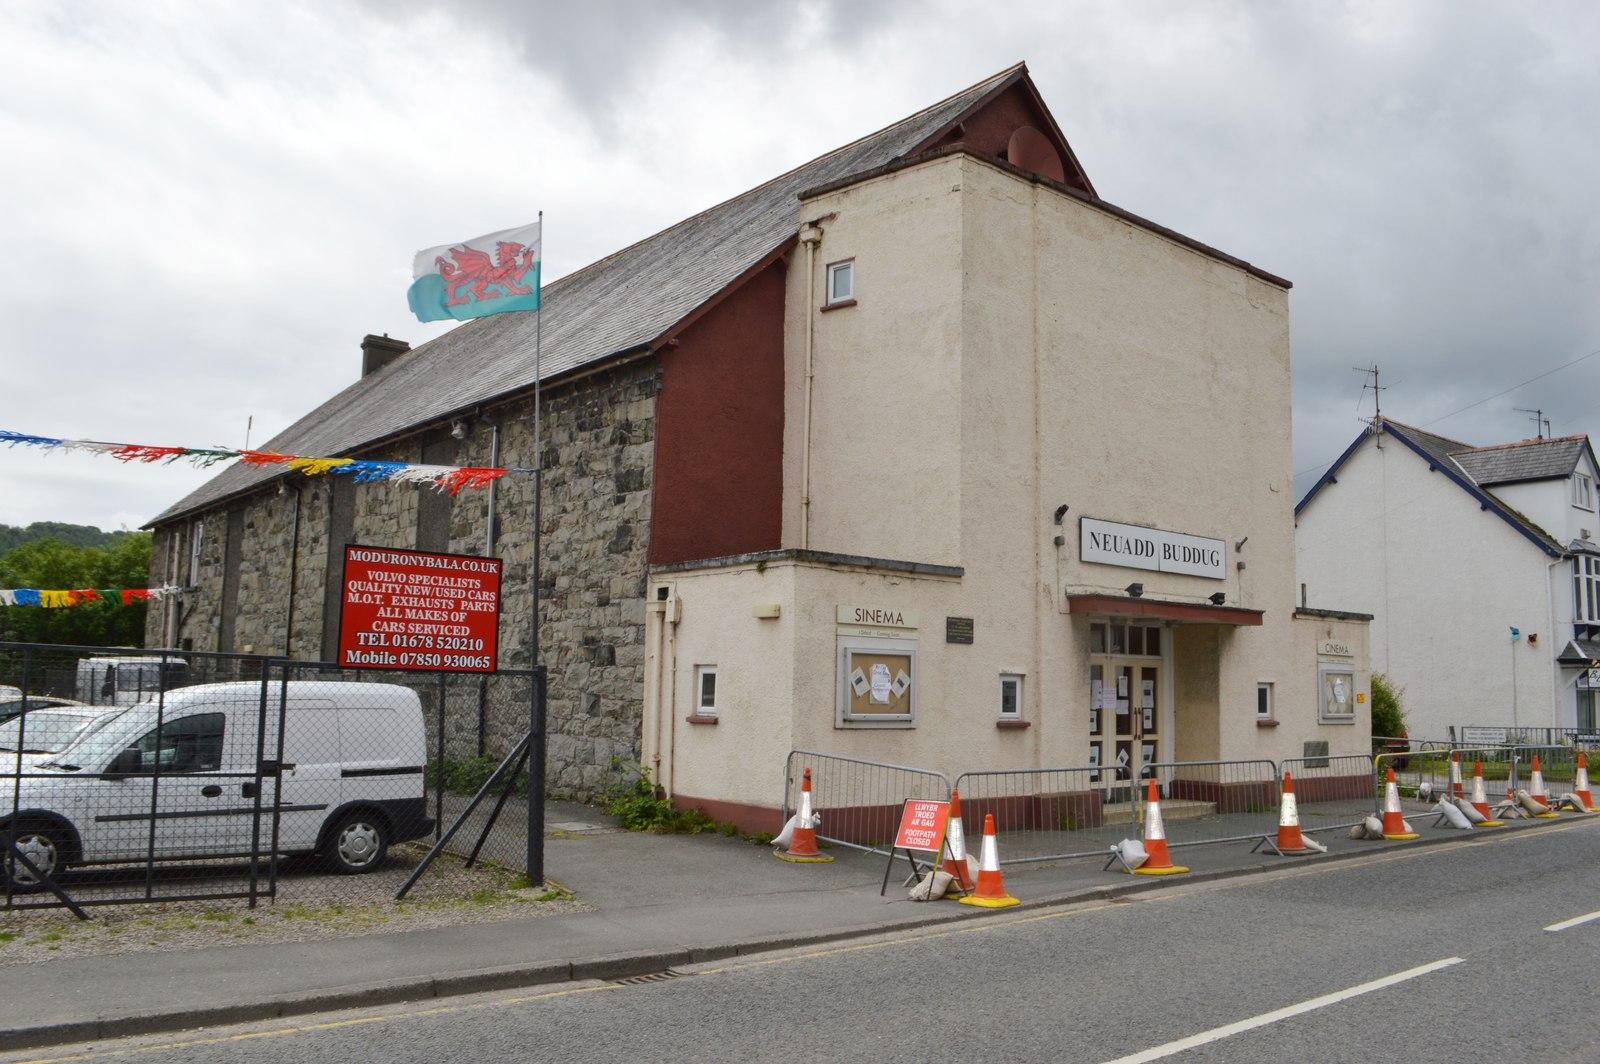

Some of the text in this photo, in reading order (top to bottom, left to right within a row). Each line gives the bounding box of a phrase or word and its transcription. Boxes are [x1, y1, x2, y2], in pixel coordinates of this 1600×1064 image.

[1090, 531, 1220, 567] NEUADD BUDDUG
[349, 550, 498, 574] MODURONYBALA.CO.UK
[367, 571, 481, 588] VOLVO SPECIALISTS
[348, 581, 496, 601] QUALITY NEW/USED CARS
[348, 593, 496, 612] M.O.T. EXHAUSTS PARTS
[377, 607, 468, 623] ALL MAKES OF
[855, 608, 904, 625] SINEMA
[372, 621, 471, 636] CARS SERVICED
[357, 632, 483, 651] TEL 01678 520210
[1325, 643, 1349, 654] CINEMA
[346, 650, 490, 668] Mobile 07850 930065
[914, 803, 938, 811] LLWYBR
[914, 811, 935, 819] TROED
[921, 819, 935, 827] GAU
[905, 829, 936, 839] FOOTPATH
[905, 837, 931, 846] CLOSED
